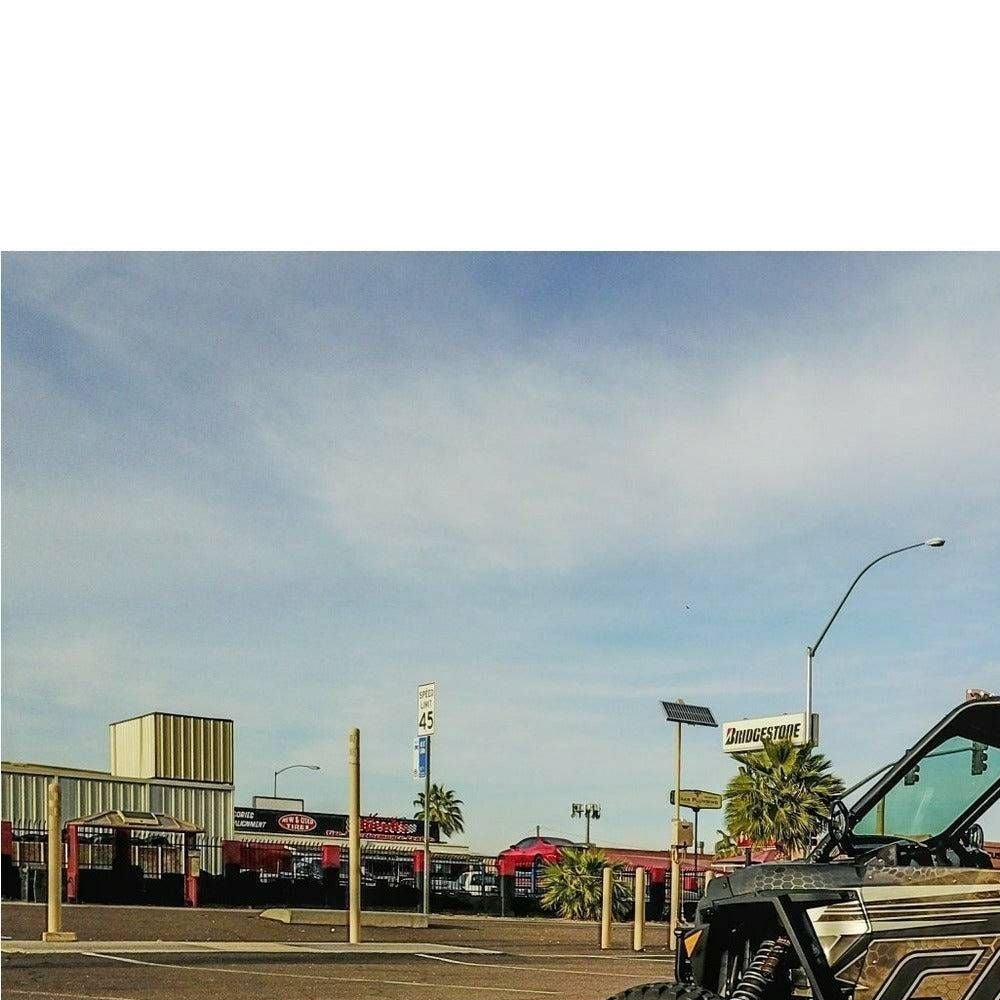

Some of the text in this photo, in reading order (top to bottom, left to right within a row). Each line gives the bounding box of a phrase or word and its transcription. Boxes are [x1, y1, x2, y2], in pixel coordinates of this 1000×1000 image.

[419, 711, 433, 729] 45
[725, 723, 801, 745] BRIDGESTONE
[286, 823, 309, 831] TIRES
